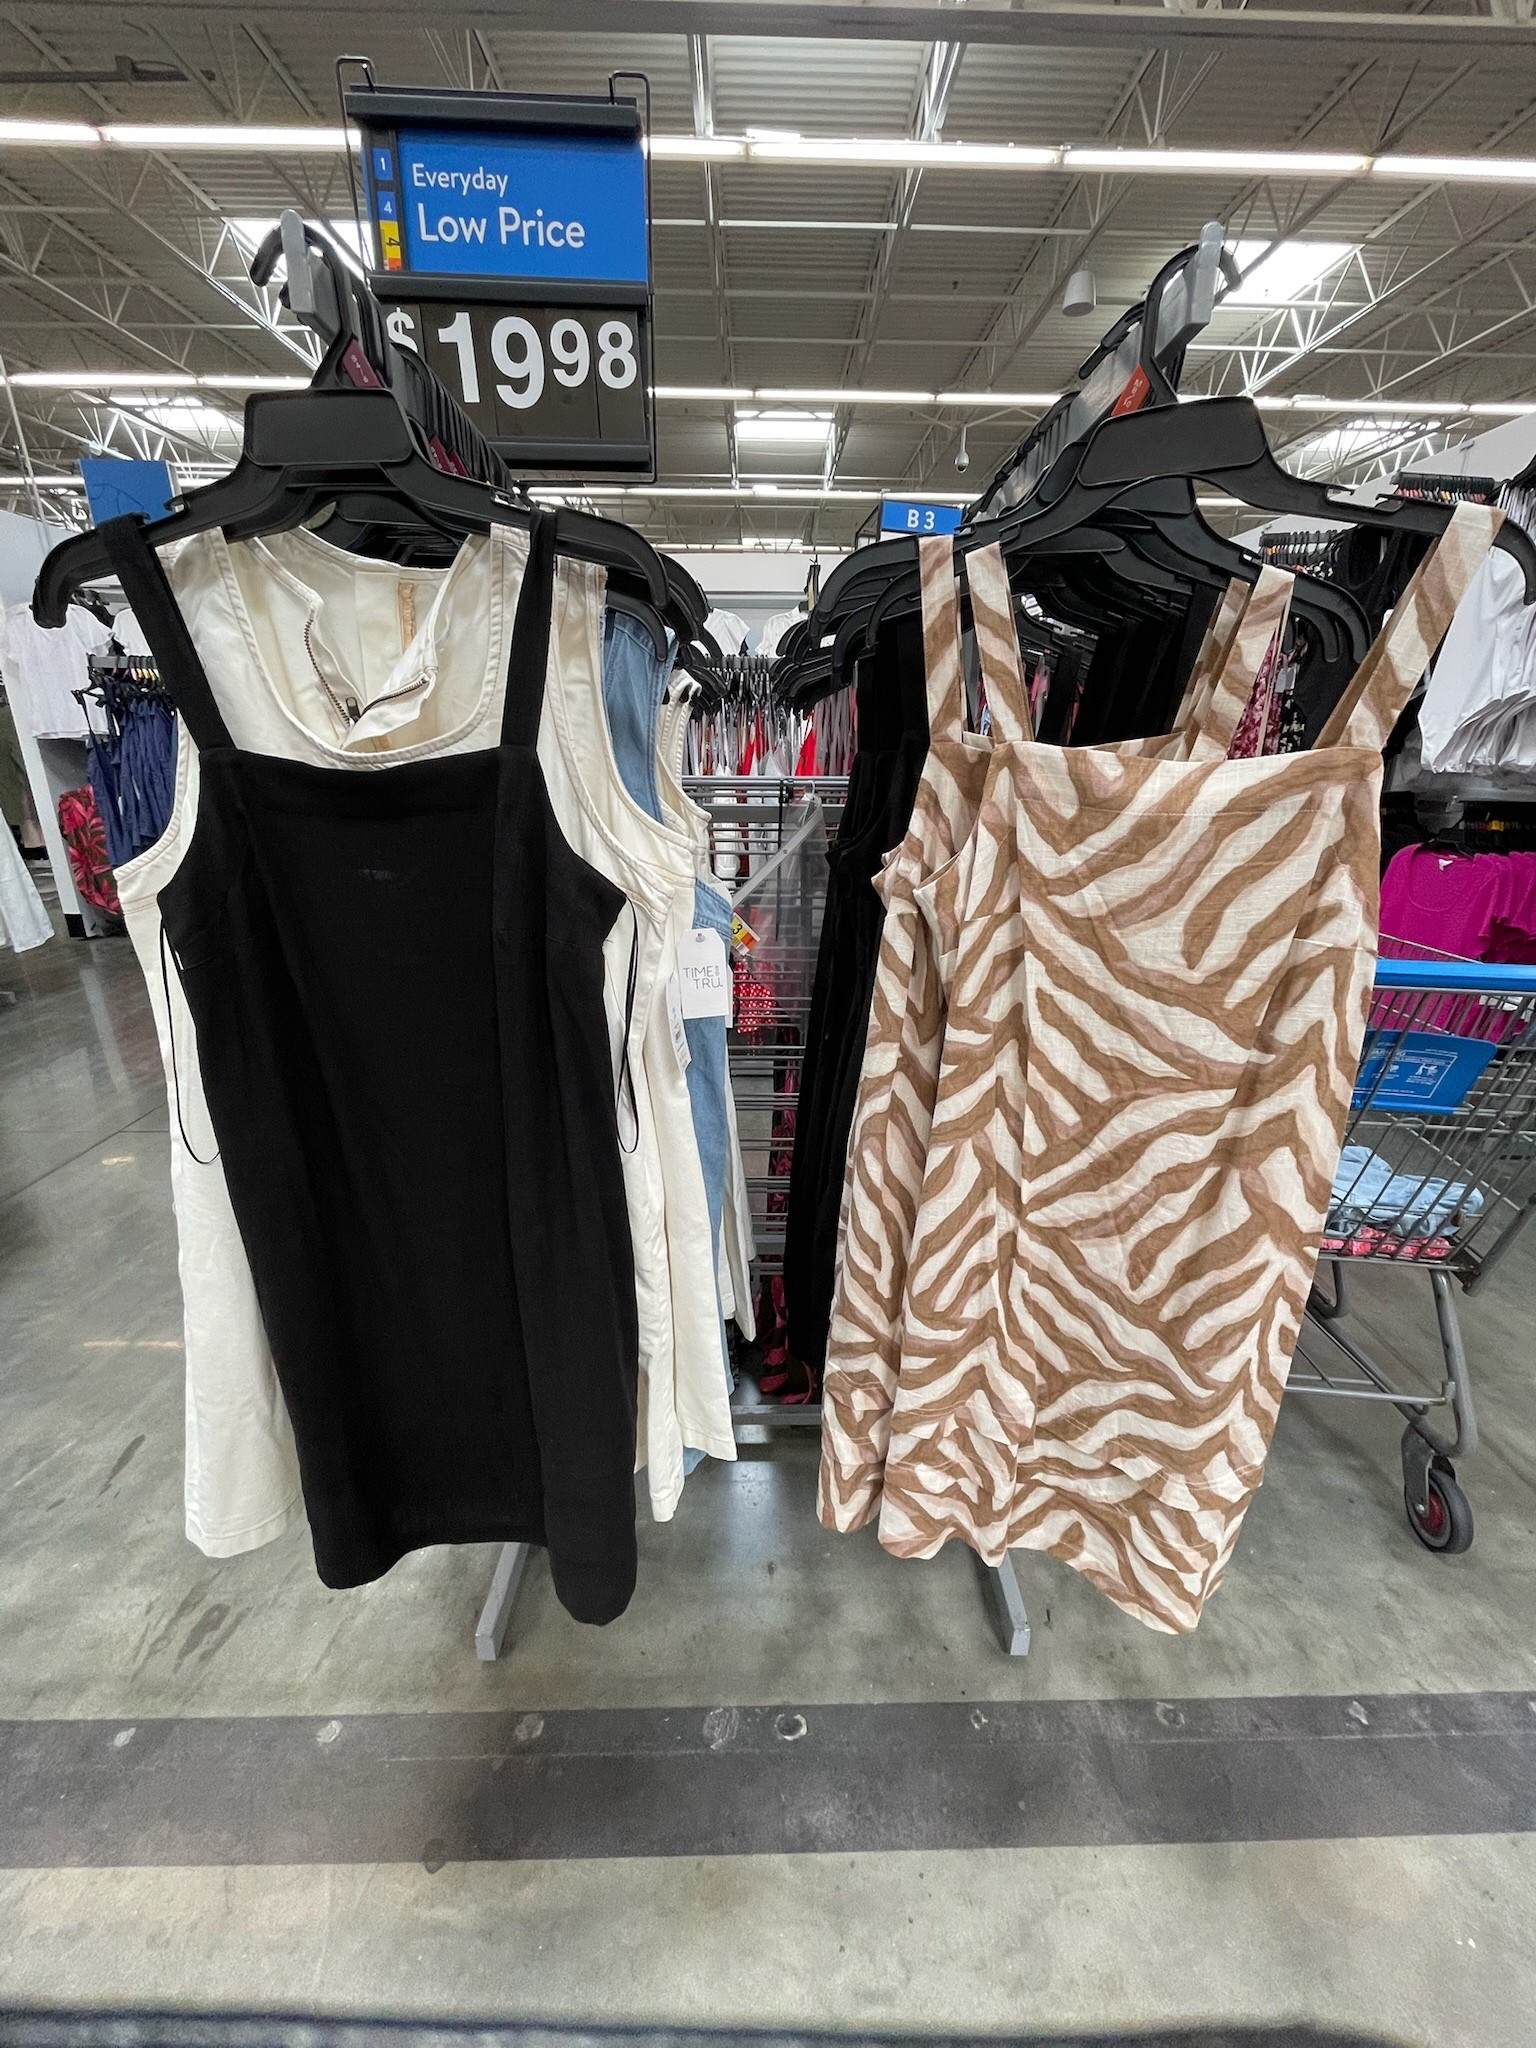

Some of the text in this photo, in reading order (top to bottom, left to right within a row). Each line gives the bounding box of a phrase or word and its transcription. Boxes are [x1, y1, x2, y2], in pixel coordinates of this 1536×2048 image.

[412, 162, 509, 198] Everyday
[417, 202, 586, 248] Low Price
[683, 965, 714, 979] TIME
